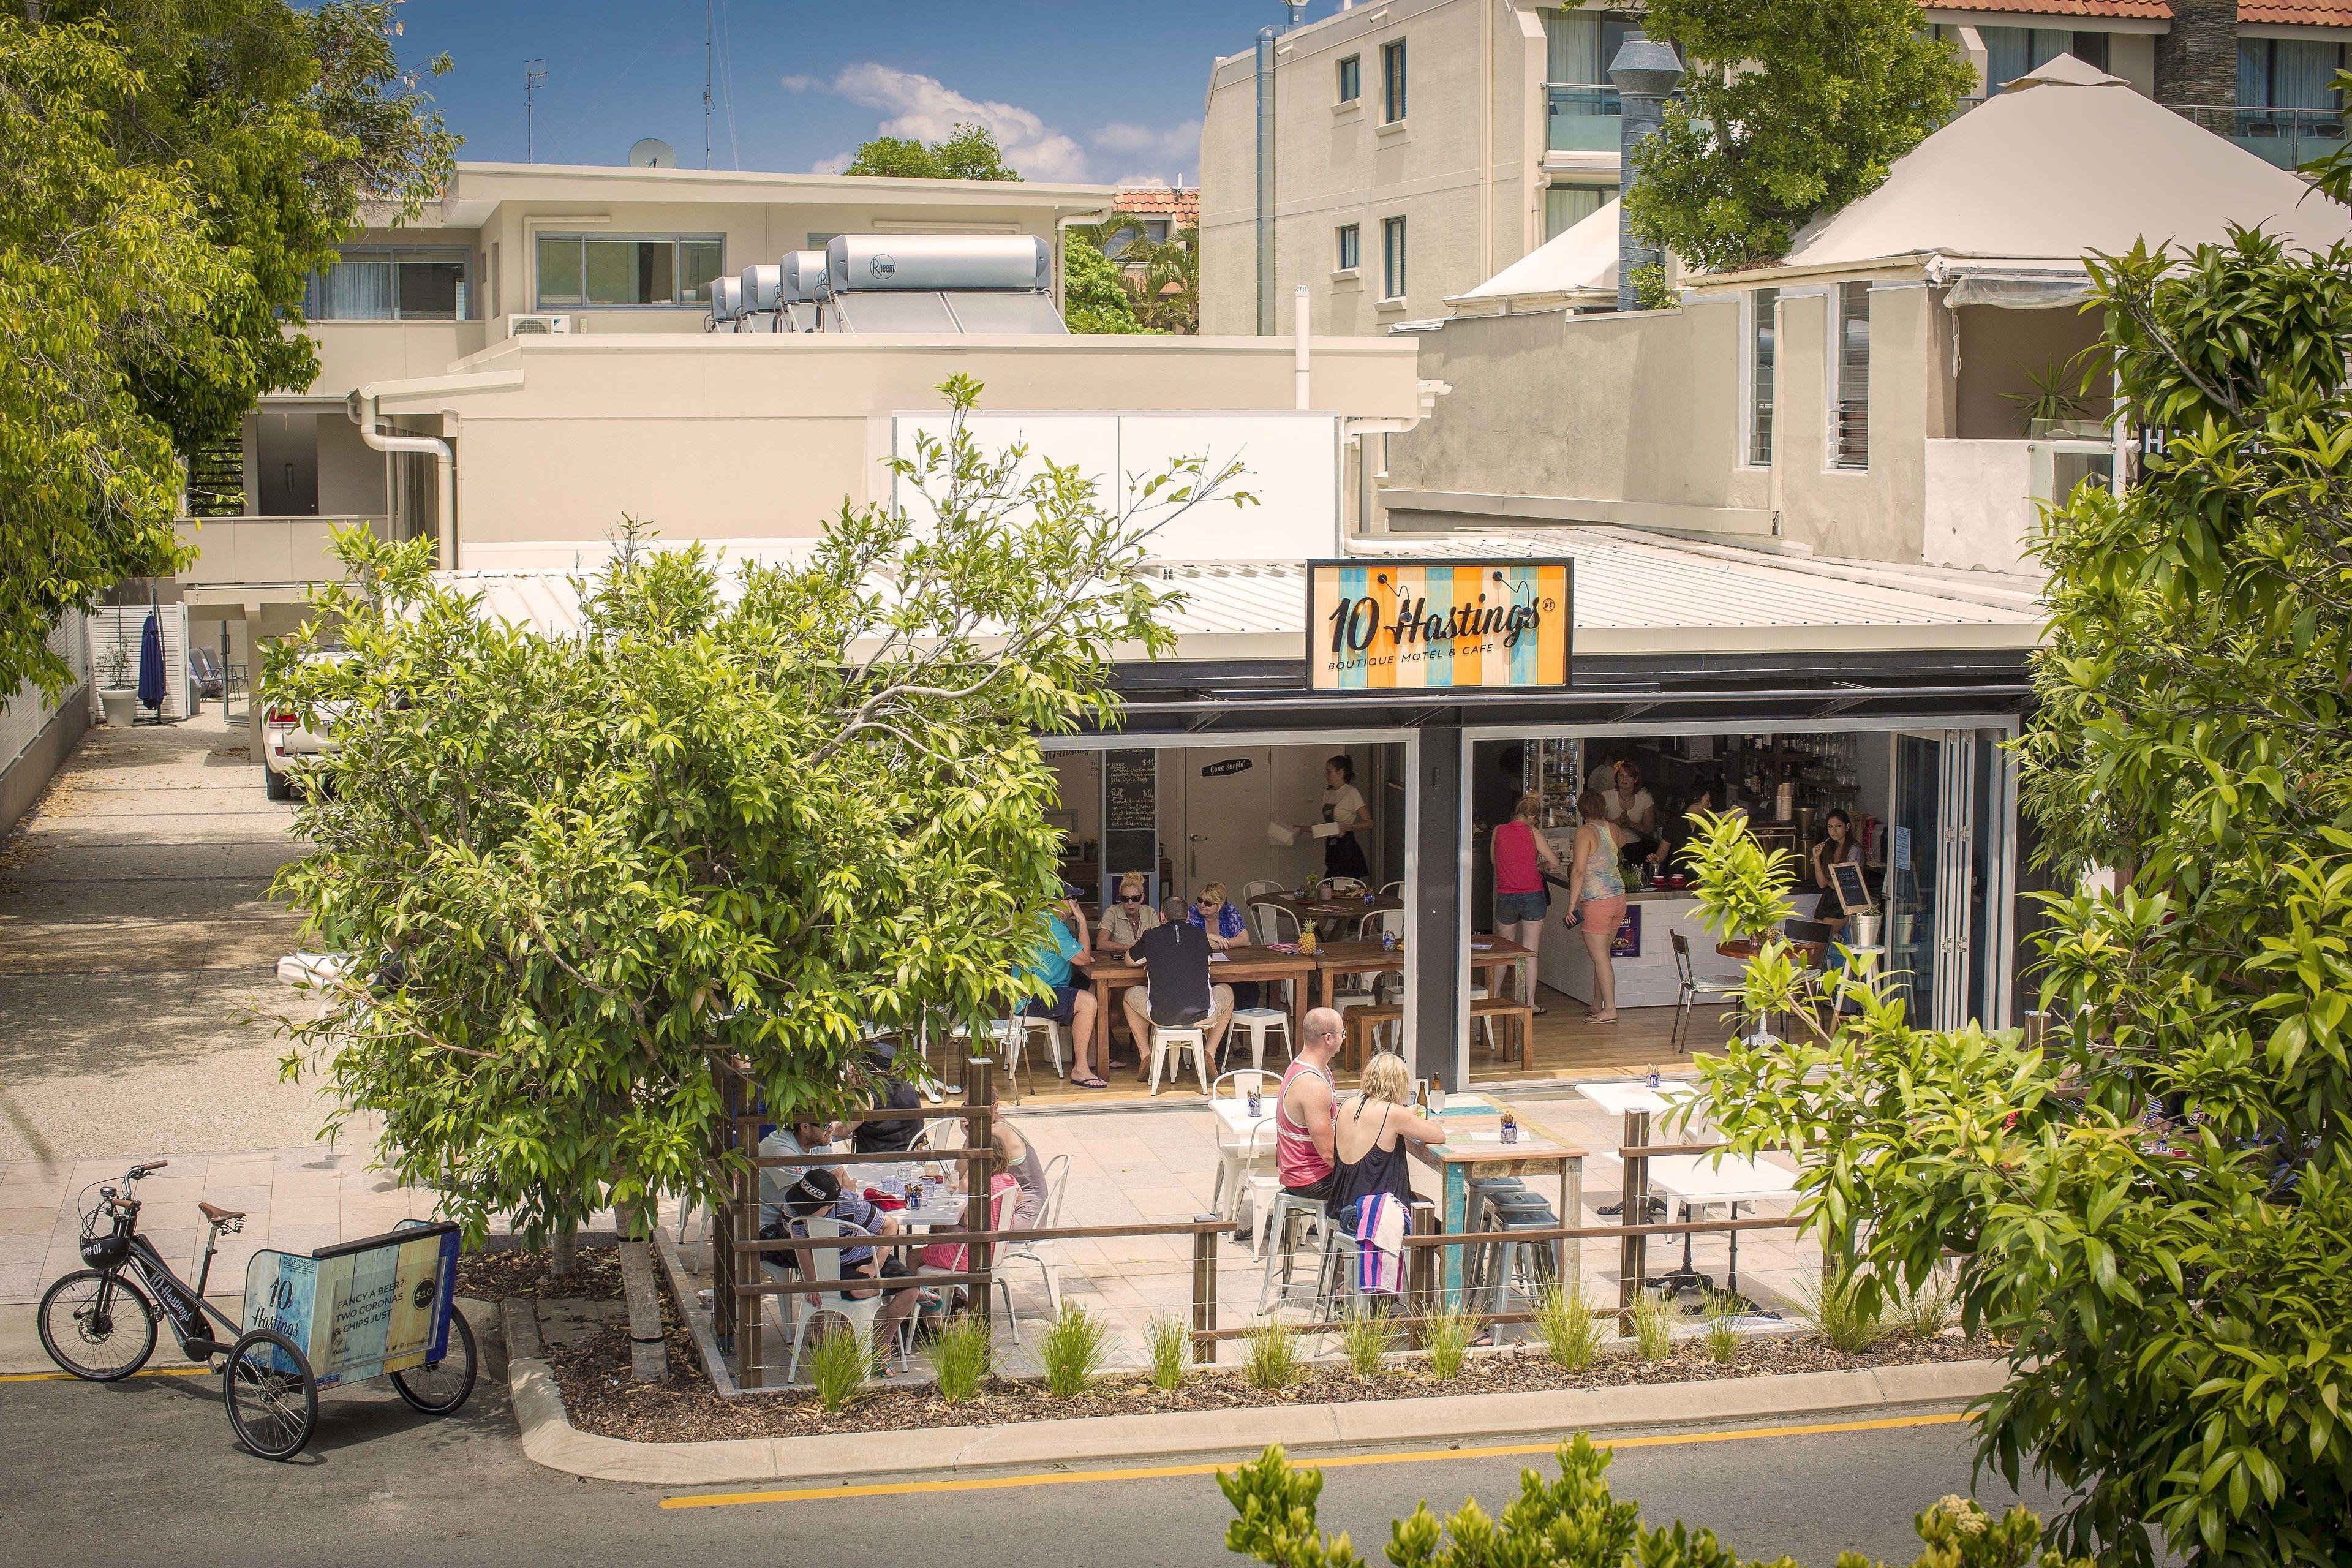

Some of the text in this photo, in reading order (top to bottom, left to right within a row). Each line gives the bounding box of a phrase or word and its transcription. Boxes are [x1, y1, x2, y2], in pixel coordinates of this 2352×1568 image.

[872, 254, 894, 276] Rheem
[1329, 597, 1380, 653] 10
[1383, 593, 1540, 648] Hastings
[1328, 655, 1394, 671] BOUTIQUE
[1401, 649, 1442, 663] MOTEL
[1463, 643, 1493, 655] CAFE
[1210, 766, 1224, 775] Gone
[1621, 916, 1631, 925] çaí
[93, 1243, 102, 1255] 10
[149, 1272, 192, 1321] 10 Hastings
[270, 1278, 293, 1310] 10
[336, 1292, 404, 1322] TWO CORONAS
[337, 1279, 404, 1310] FANCY A BEER?
[415, 1287, 434, 1301] $10
[251, 1306, 300, 1338] Hastings
[343, 1317, 369, 1333] CHIPS
[370, 1309, 392, 1324] JUST
